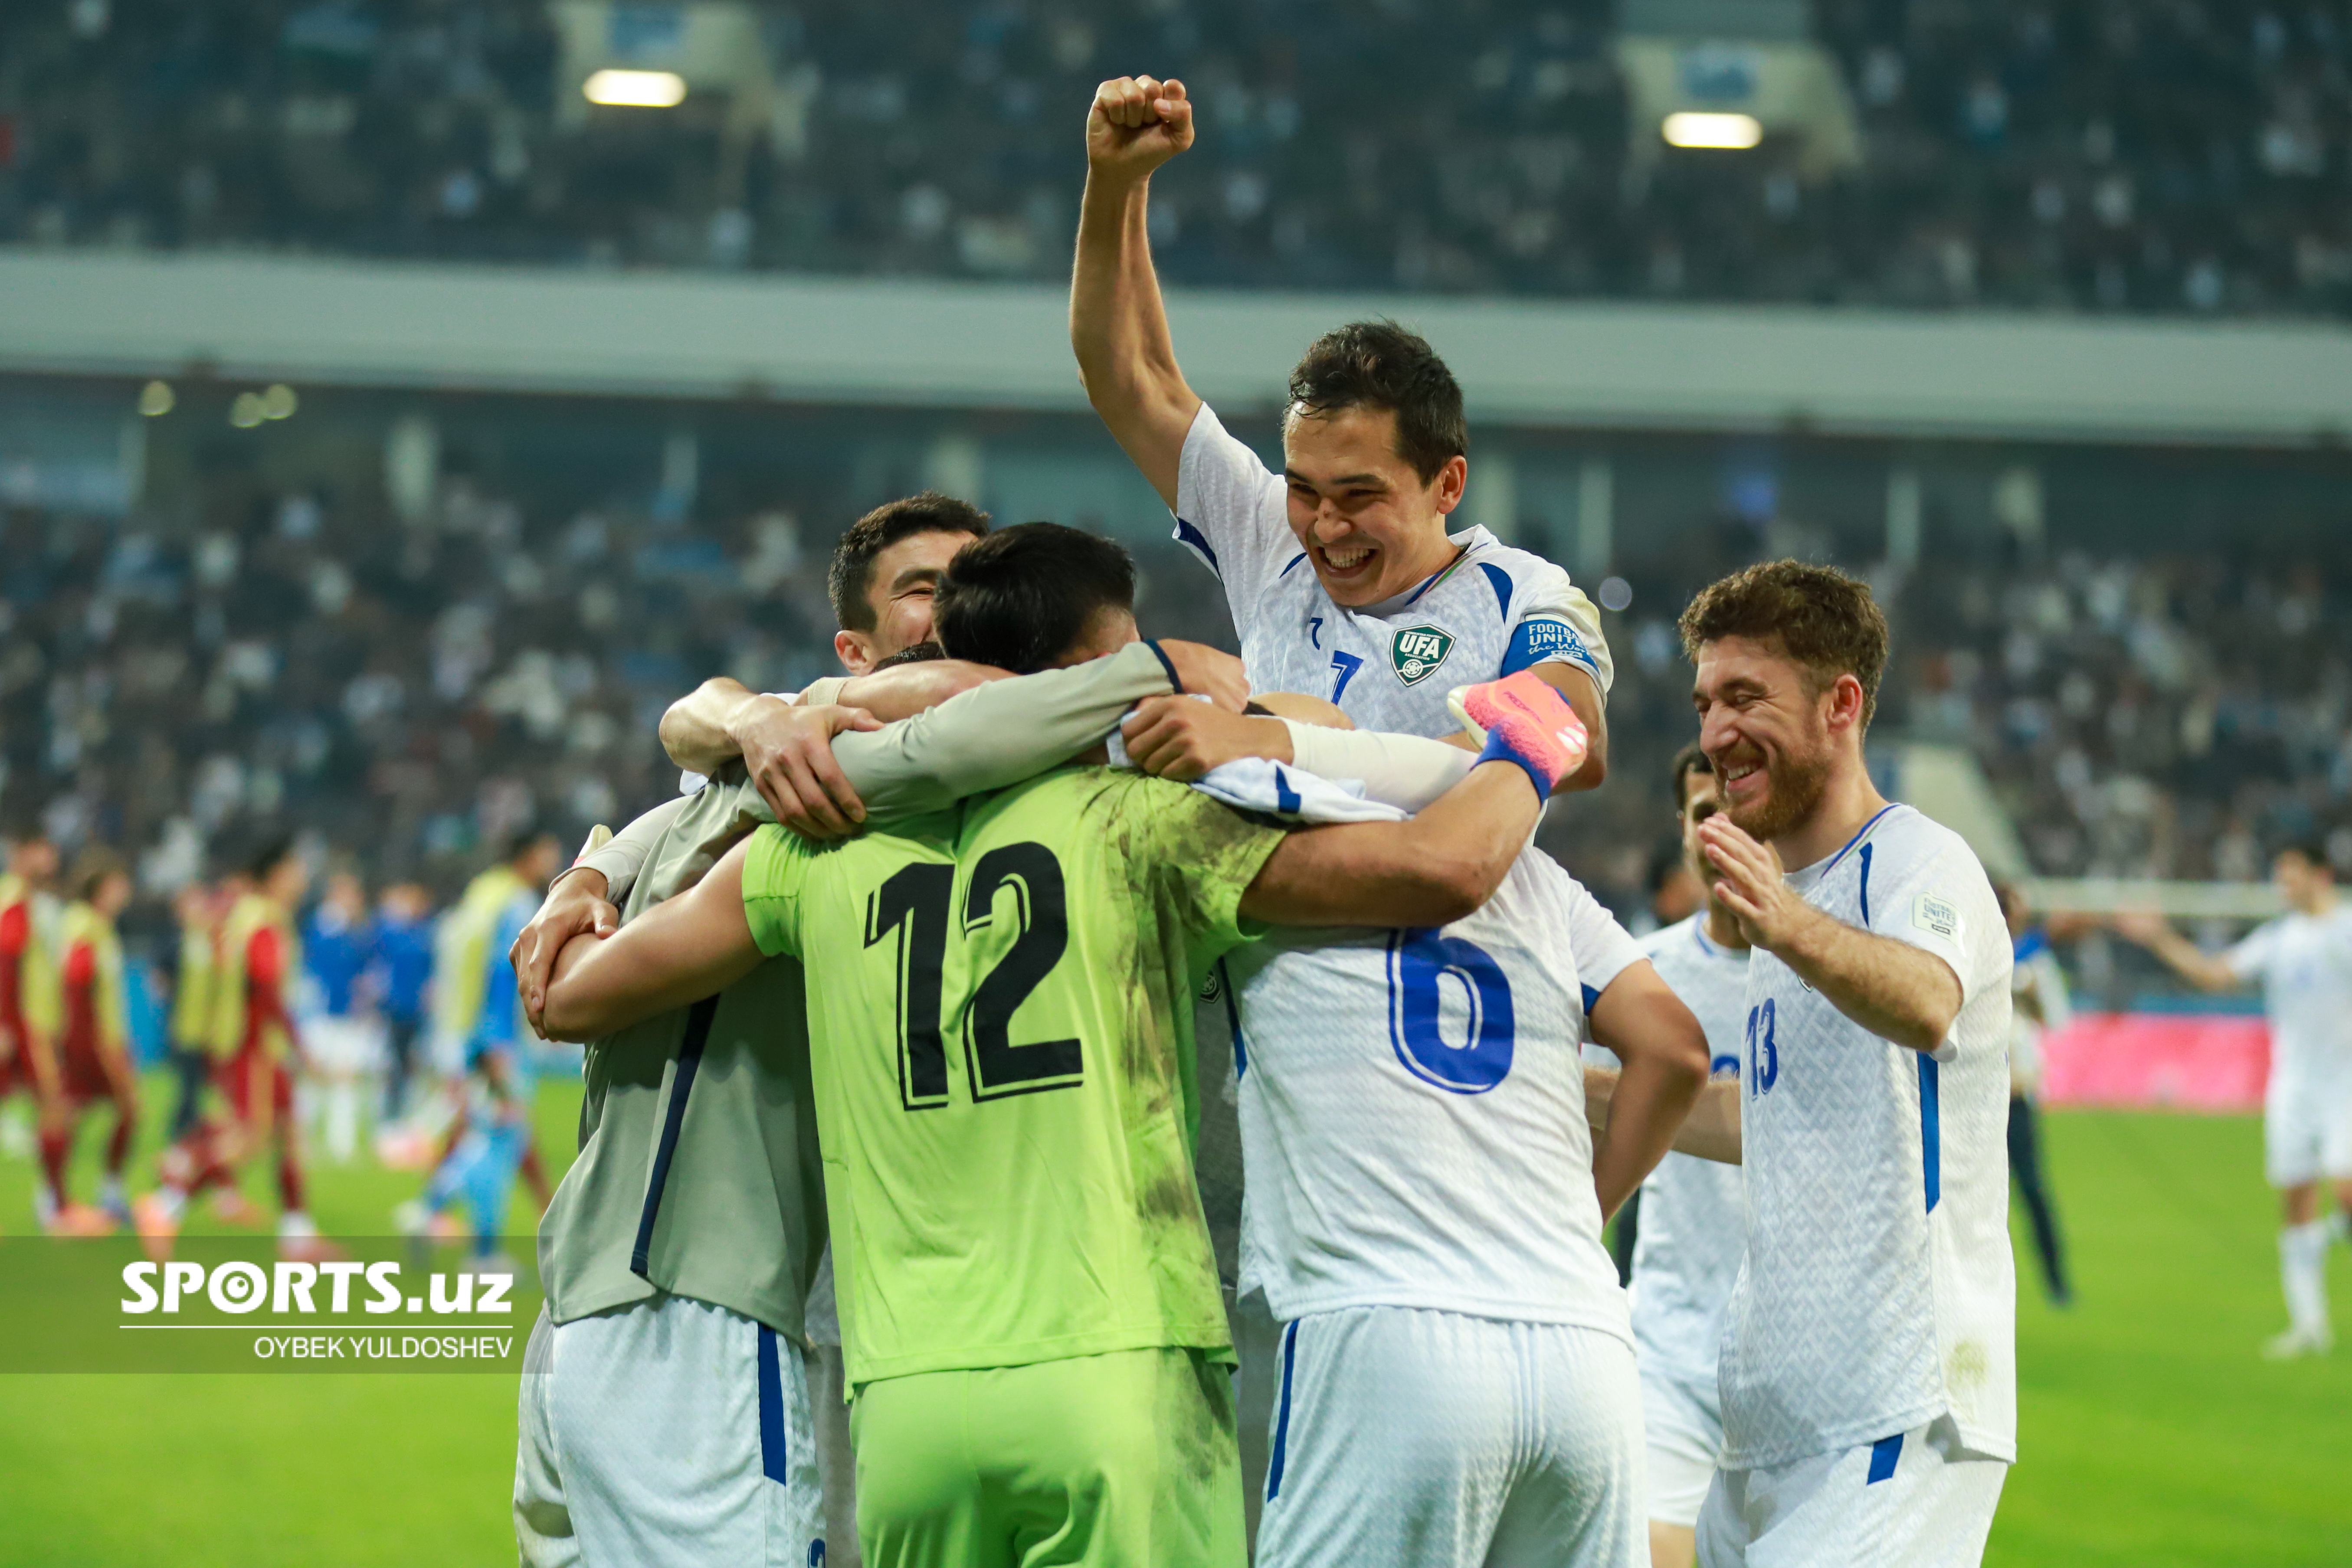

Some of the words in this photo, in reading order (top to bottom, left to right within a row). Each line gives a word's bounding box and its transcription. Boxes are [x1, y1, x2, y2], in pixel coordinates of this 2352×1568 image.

[1330, 650, 1364, 706] 7
[1399, 634, 1440, 659] UFA
[864, 841, 1084, 1111] 12
[1386, 927, 1515, 1095] 6
[1746, 998, 1778, 1101] 13
